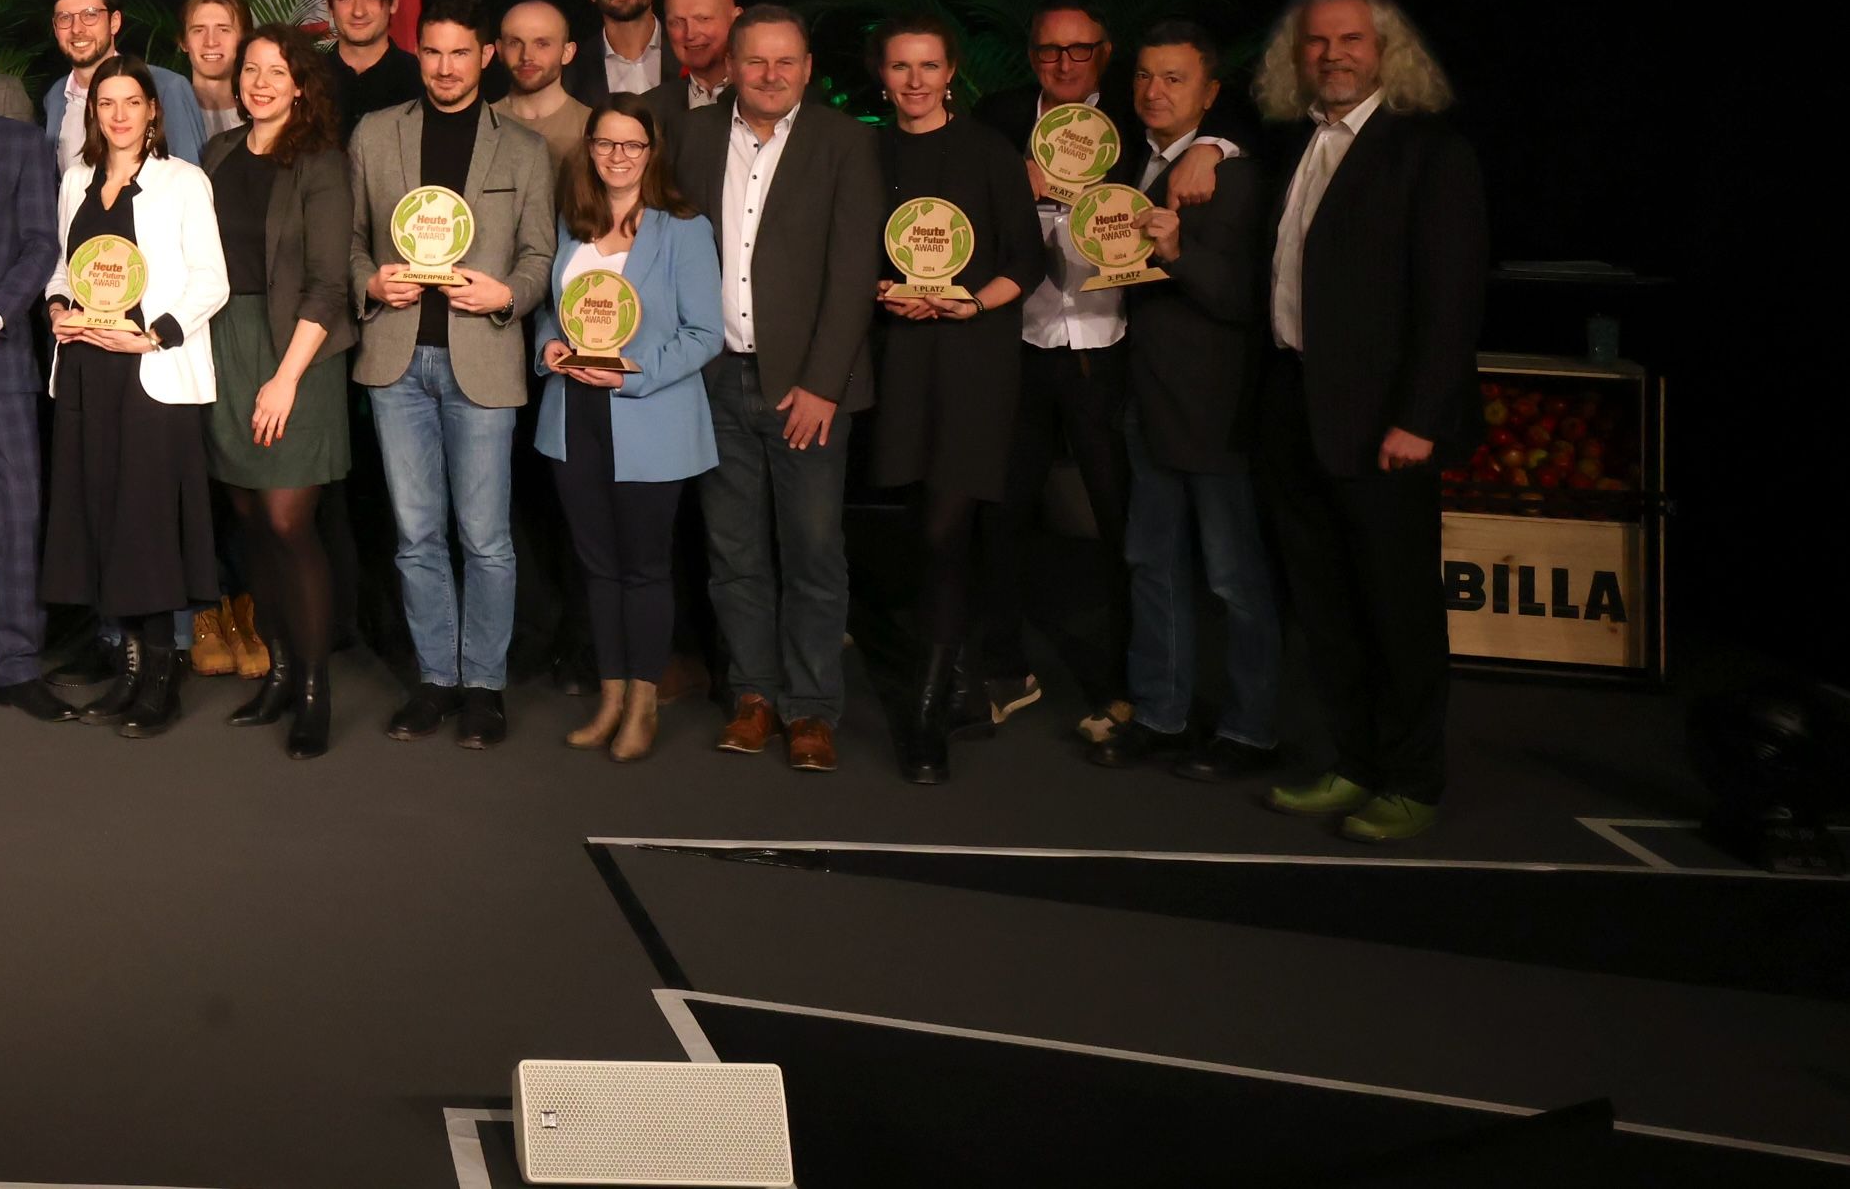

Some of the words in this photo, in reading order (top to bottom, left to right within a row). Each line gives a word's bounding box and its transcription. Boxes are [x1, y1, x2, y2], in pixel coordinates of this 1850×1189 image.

[1054, 136, 1068, 146] For
[1061, 128, 1095, 147] Heute
[1057, 145, 1088, 161] AWARD
[1049, 185, 1074, 198] PLATZ
[417, 214, 448, 225] Heute
[1095, 212, 1129, 226] Heute
[912, 226, 946, 236] Heute
[1092, 226, 1106, 234] For
[417, 231, 446, 241] AWARD
[923, 236, 950, 244] Future
[1100, 229, 1132, 242] AWARD
[914, 244, 944, 253] AWARD
[93, 261, 123, 272] Heute
[402, 273, 455, 281] SONDERPREIS
[1116, 270, 1141, 281] PLATZ
[93, 278, 120, 288] AWARD
[583, 297, 614, 309] Heute
[579, 307, 591, 315] For
[94, 317, 117, 325] PLATZ
[584, 315, 612, 325] AWARD
[1444, 560, 1628, 623] BILLA
